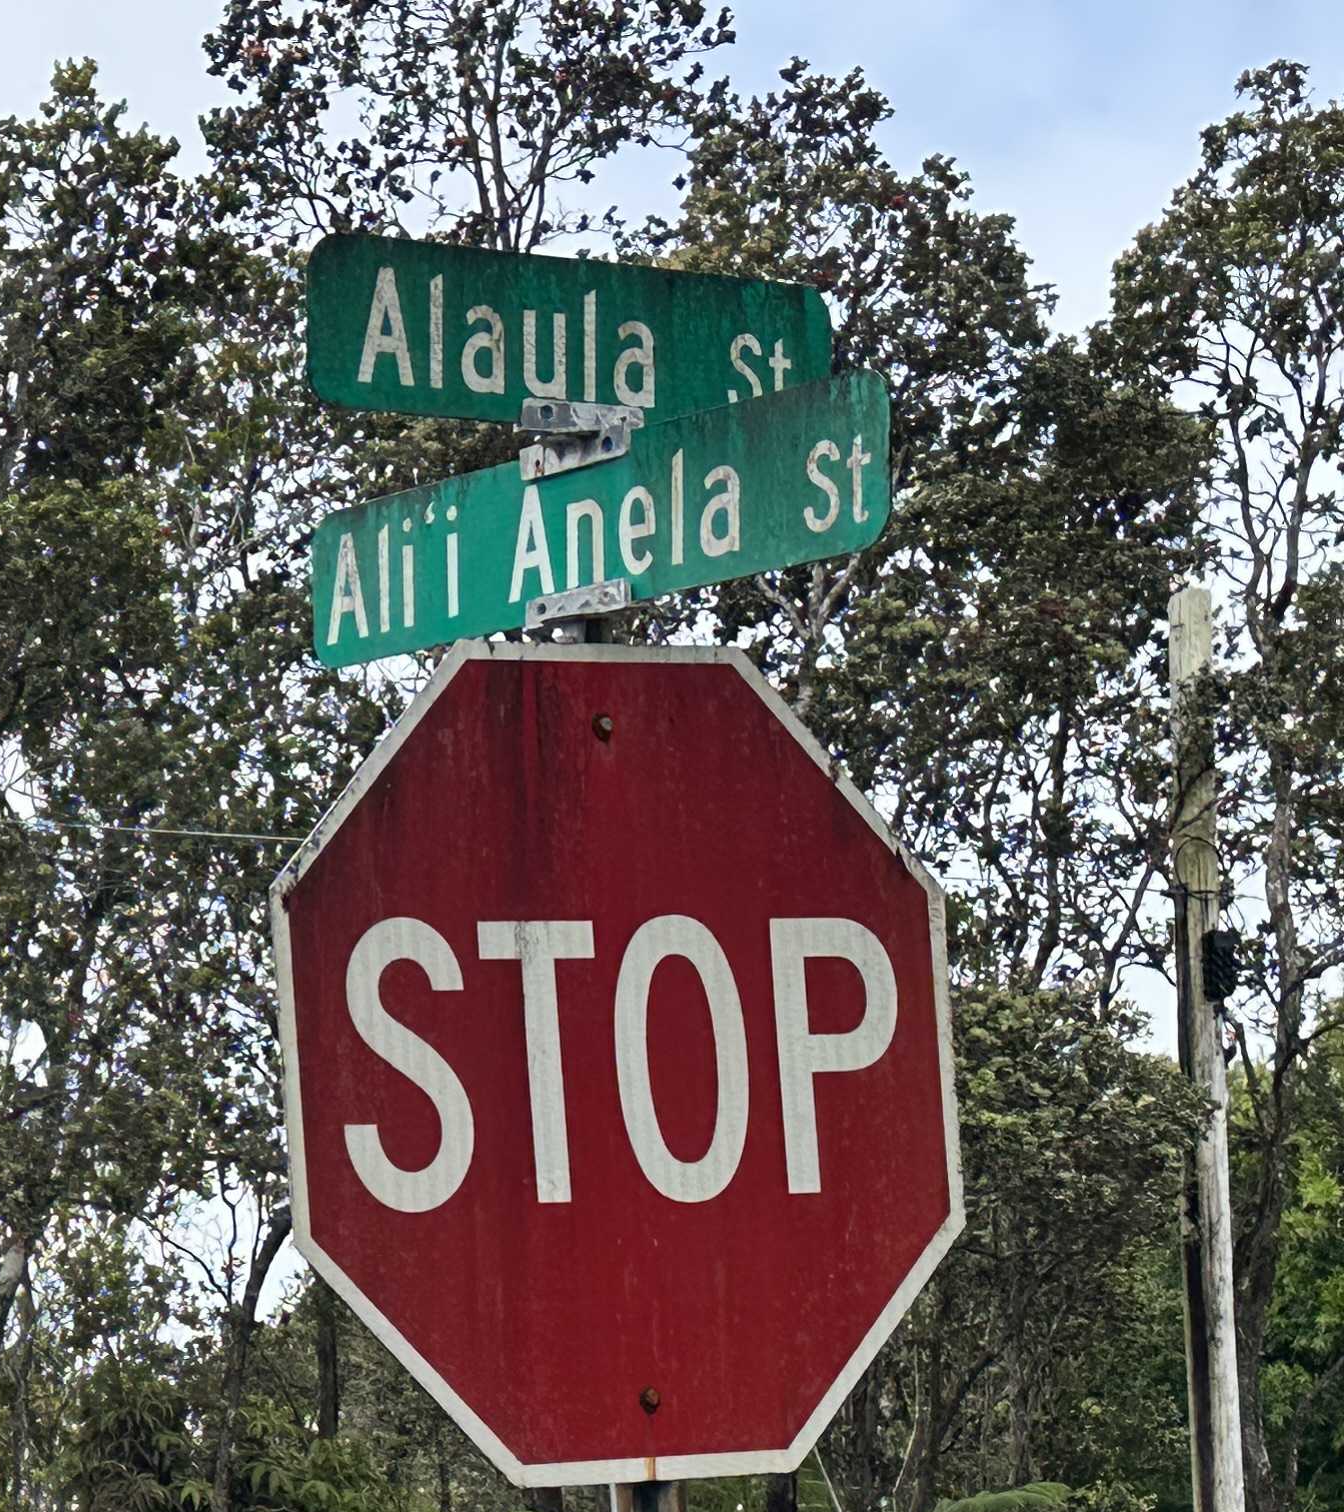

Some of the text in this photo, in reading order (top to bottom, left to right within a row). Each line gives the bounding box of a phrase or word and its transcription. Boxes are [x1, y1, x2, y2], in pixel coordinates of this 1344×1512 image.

[357, 267, 792, 408] Alaula St
[509, 448, 740, 603] Anela
[803, 434, 872, 533] St
[344, 914, 898, 1213] STOP
